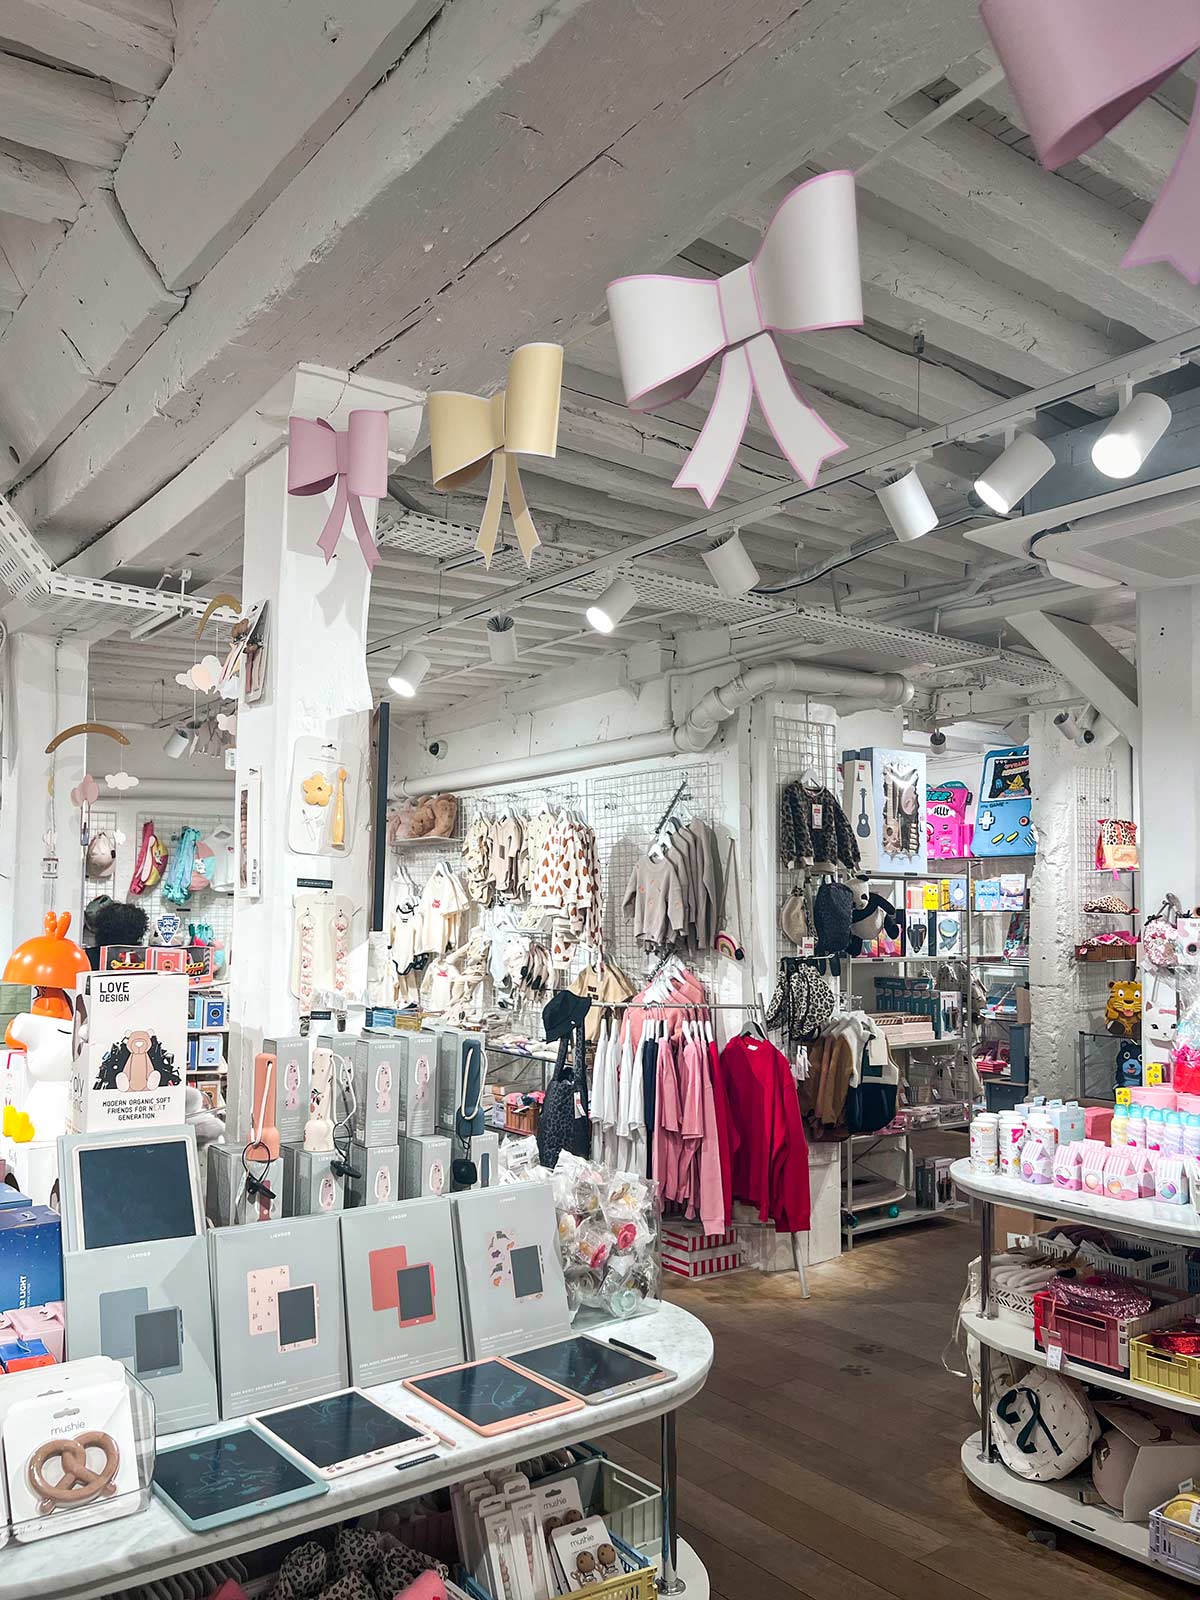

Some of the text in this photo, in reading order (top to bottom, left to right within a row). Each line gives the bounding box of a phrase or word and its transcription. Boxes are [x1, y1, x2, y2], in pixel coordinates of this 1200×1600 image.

[934, 806, 950, 816] JELLY
[99, 981, 130, 993] LOVE
[99, 993, 130, 1002] DESIGN
[102, 1096, 171, 1107] MODERN ORGANIC SOFT
[107, 1106, 133, 1114] FRIENDS
[148, 1104, 166, 1112] NEXT
[118, 1112, 155, 1121] GENERATION
[50, 1419, 86, 1436] mushie
[543, 1497, 567, 1510] mushie
[570, 1533, 595, 1548] mushie
